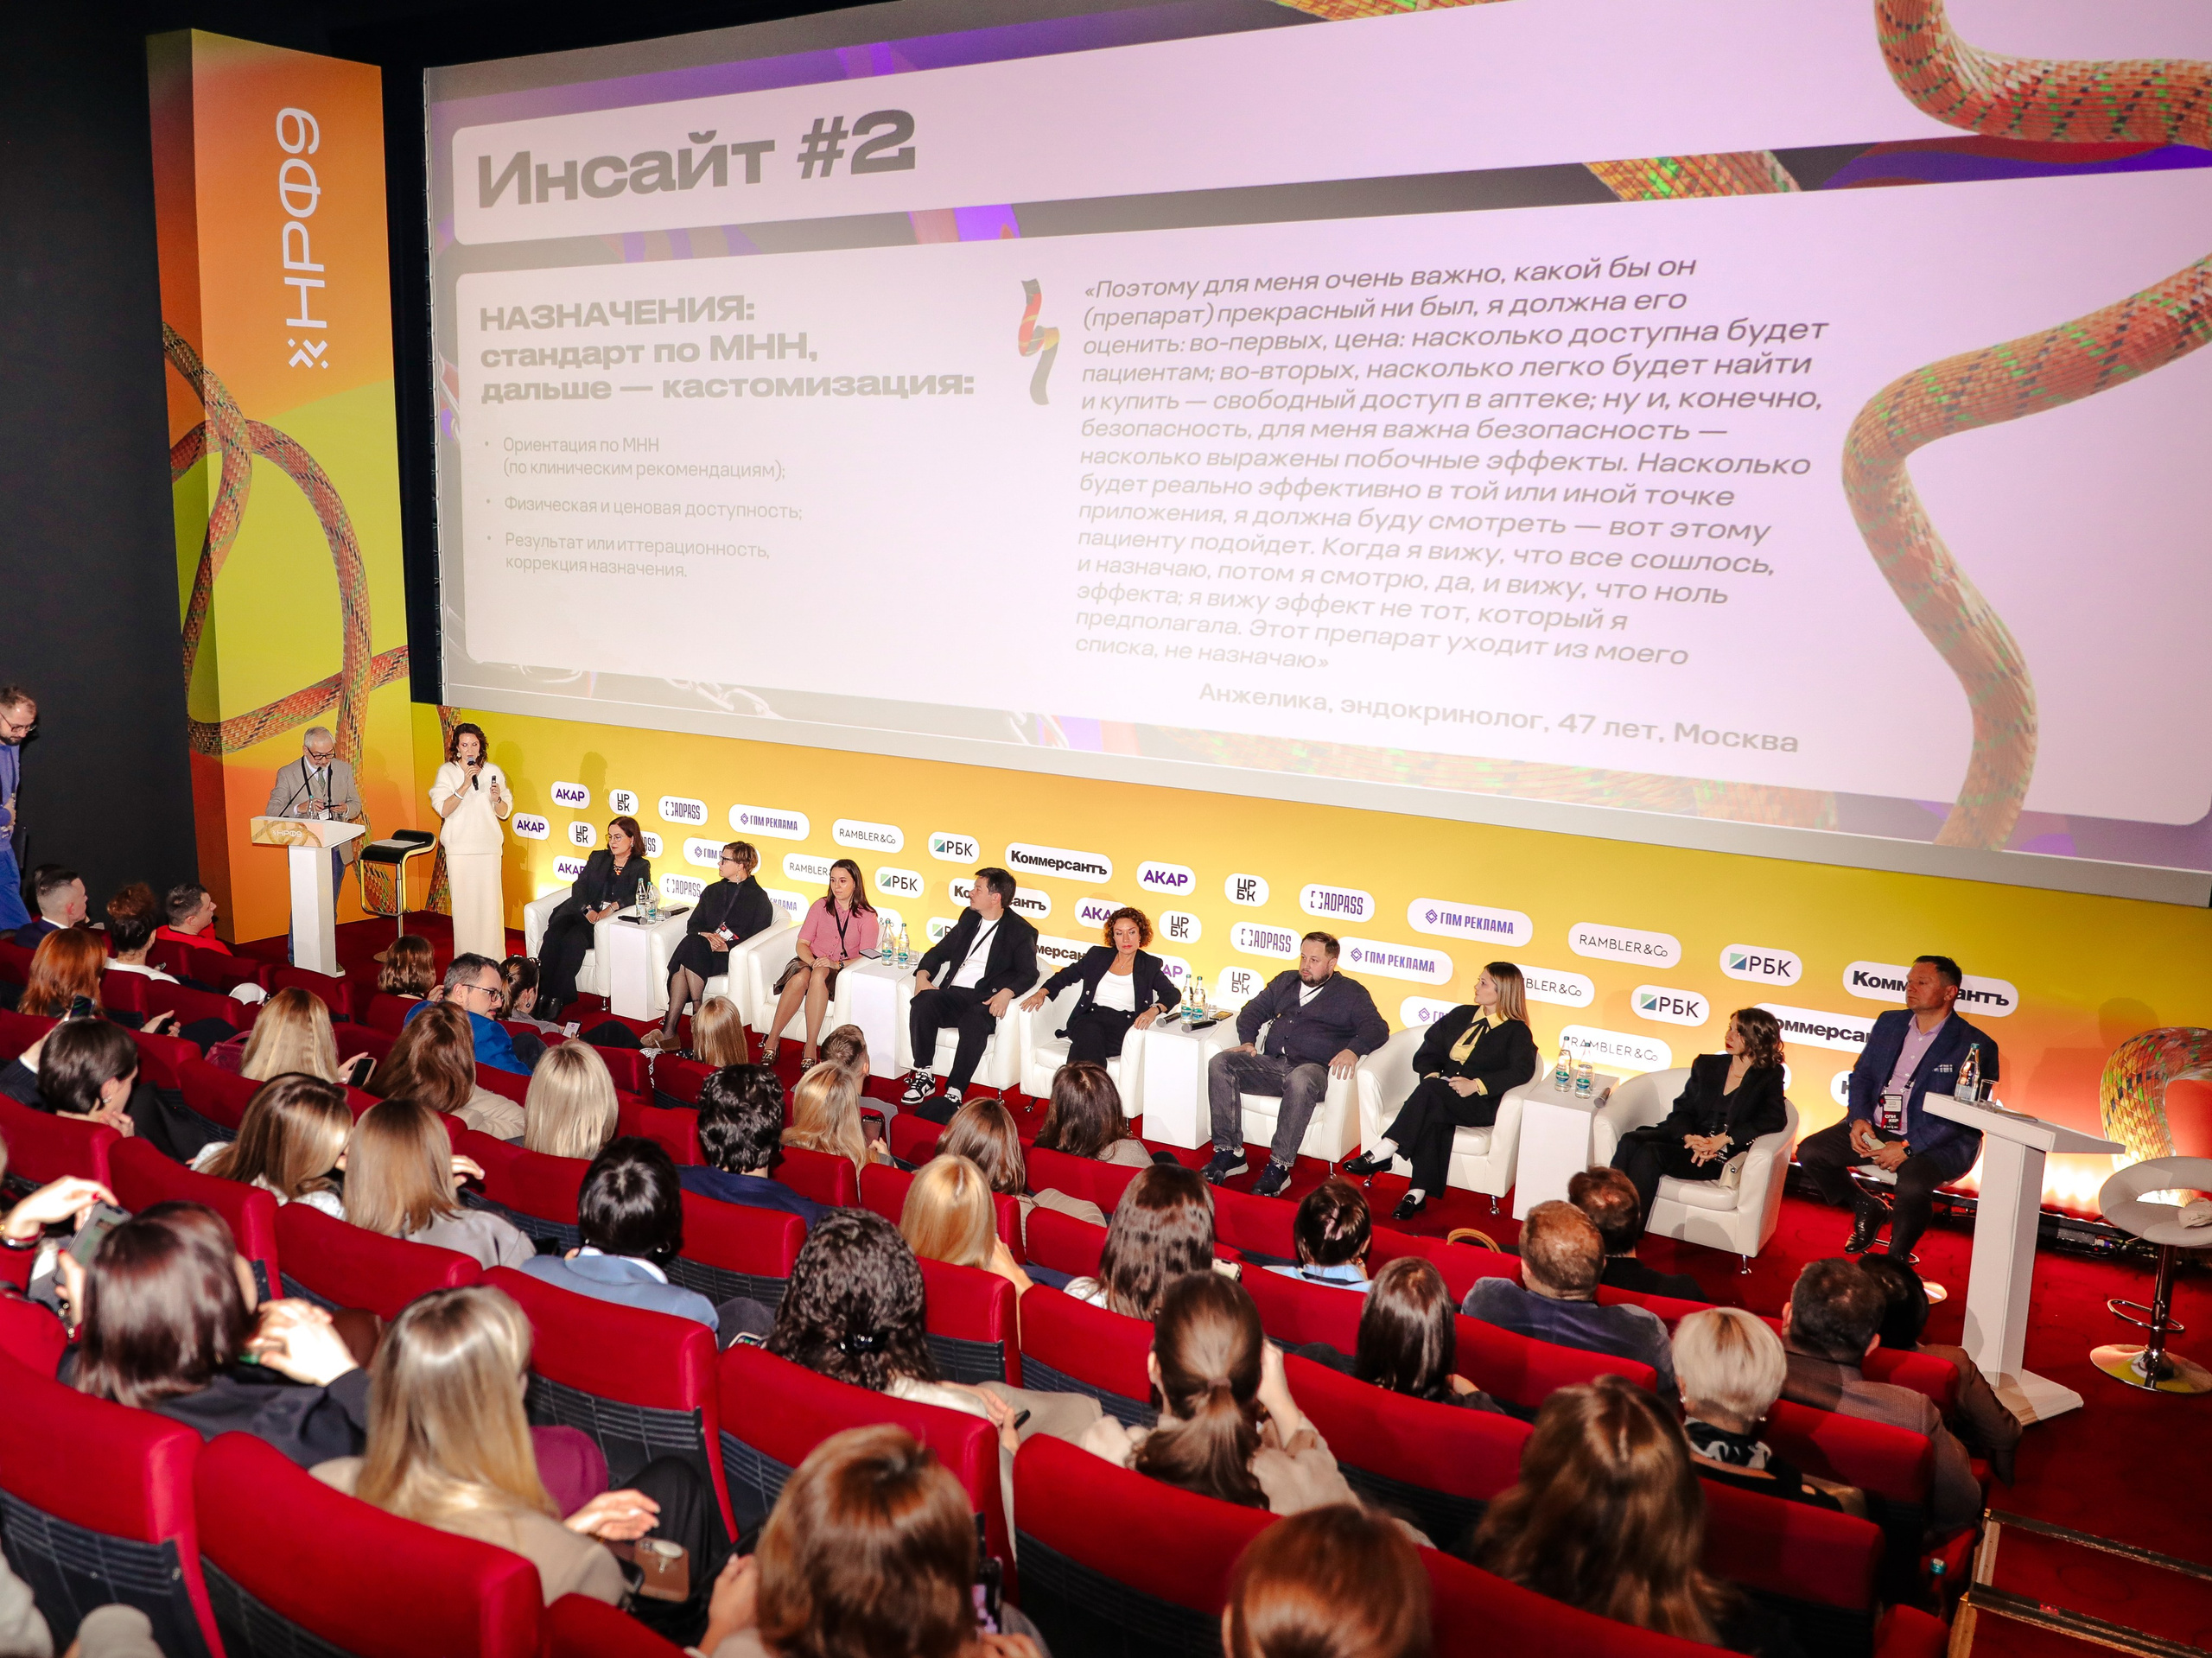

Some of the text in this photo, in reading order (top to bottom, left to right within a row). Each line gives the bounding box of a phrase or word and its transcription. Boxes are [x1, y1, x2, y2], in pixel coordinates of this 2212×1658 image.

[478, 109, 916, 209] Инсайт #2
[276, 107, 327, 328] НРФ9
[1084, 255, 1697, 301] «Поэтому для меня очень важно, какой бы он
[480, 295, 755, 332] НАЗНАЧЕНИЯ:
[1084, 293, 1688, 332] (препарат) прекрасный был, должна его
[1083, 317, 1830, 357] оценить: во-первых, цена: насколько доступна будет
[480, 332, 817, 371] стандарт по МНН,
[1082, 352, 1813, 385] пациентам; во-вторых, насколько легко будет найти
[480, 374, 975, 404] дальше кастомизация:
[1100, 388, 1821, 416] купить свободный доступ аптеке; ну конечно,
[1081, 417, 1690, 441] безопасность, для меня важна безопасность
[503, 436, 659, 456] Ориентация по МНН
[503, 456, 785, 482] (по клиническим рекомендациям);
[1080, 448, 1811, 477] насколько выражены побочные эффекты. Насколько
[1080, 472, 1735, 506] будет реально эффективно той или иной точке
[505, 495, 803, 522] Физическая ценовая доступность;
[1078, 505, 1772, 547] приложения, должна буду смотреть вот этому
[505, 531, 770, 560] Результат или иттерационность,
[1077, 532, 1774, 576] пациенту подойдет. Когда вижу, что все сошлось,
[505, 557, 688, 578] коррекция назначения.
[1096, 560, 1728, 604] назначаю, потом смотрю, да, вижу, что ноль
[1077, 581, 1604, 632] эффекта; вижу эффект тот, который
[1076, 612, 1689, 665] предполагала. Этот препарат уходит моего
[1075, 638, 1329, 669] списка, назначаю»
[1198, 683, 1799, 753] Анжелика, эндокринолог, 47 лет, Москва
[556, 789, 585, 802] АКАР
[617, 793, 630, 804] ЦР
[617, 802, 630, 812] БК
[675, 803, 700, 820] ADPASS
[276, 829, 302, 838] НРФ9
[517, 820, 544, 833] АКАР
[576, 826, 588, 836] ЦР
[750, 816, 798, 830] ГПМ РЕКЛАМА
[576, 835, 588, 843] БК
[947, 841, 973, 857] РБК
[704, 848, 717, 859] ГПМ
[1011, 850, 1107, 875] Коммерсантъ
[790, 862, 830, 876] RAMBLER
[1144, 870, 1187, 886] АКАР
[676, 880, 701, 898] ADPASS
[893, 876, 917, 891] РБК
[1237, 878, 1256, 891] ЦР
[1237, 889, 1255, 901] БК
[1325, 893, 1363, 915] ADPASS
[1081, 905, 1111, 921] АКА
[1171, 916, 1189, 928] ЦР
[1440, 912, 1513, 934] ГПМ РЕКЛАМА
[1171, 926, 1188, 938] БК
[1254, 931, 1291, 952] ADPASS
[1365, 950, 1434, 973] ГПМ РЕКЛАМА
[1749, 956, 1791, 977] РБК
[1232, 971, 1250, 985] ЦР
[1232, 982, 1249, 994] БК
[1524, 978, 1581, 997] BLER&Co
[1853, 970, 2009, 1006] Коммантъ
[1659, 997, 1699, 1018] РБК
[1777, 1019, 1870, 1044] оммерса
